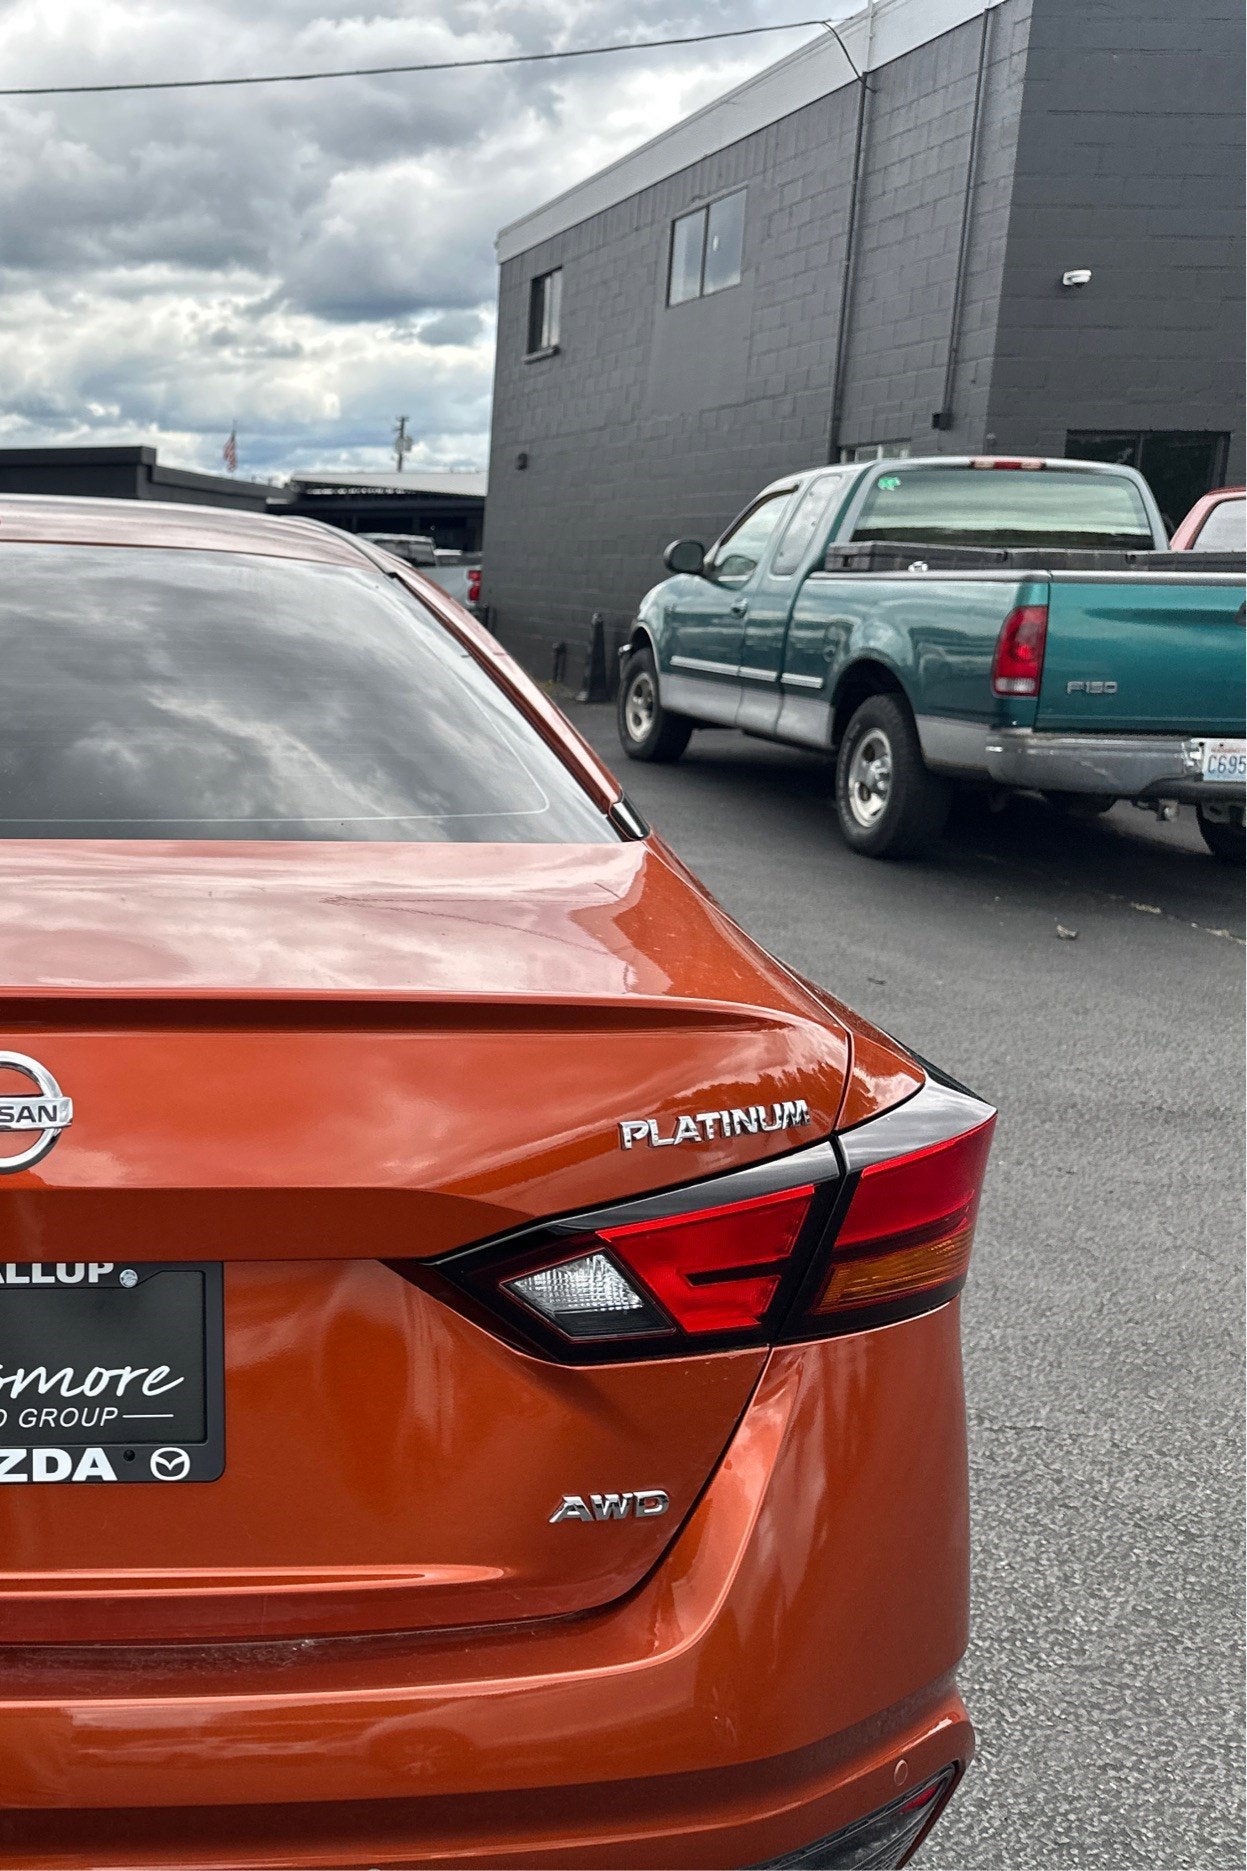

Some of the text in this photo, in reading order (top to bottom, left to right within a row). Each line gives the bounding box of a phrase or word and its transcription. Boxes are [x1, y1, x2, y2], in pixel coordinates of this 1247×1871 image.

[620, 1099, 811, 1150] PLATINUM
[19, 1407, 119, 1428] GROUP
[549, 1490, 670, 1523] AWD
